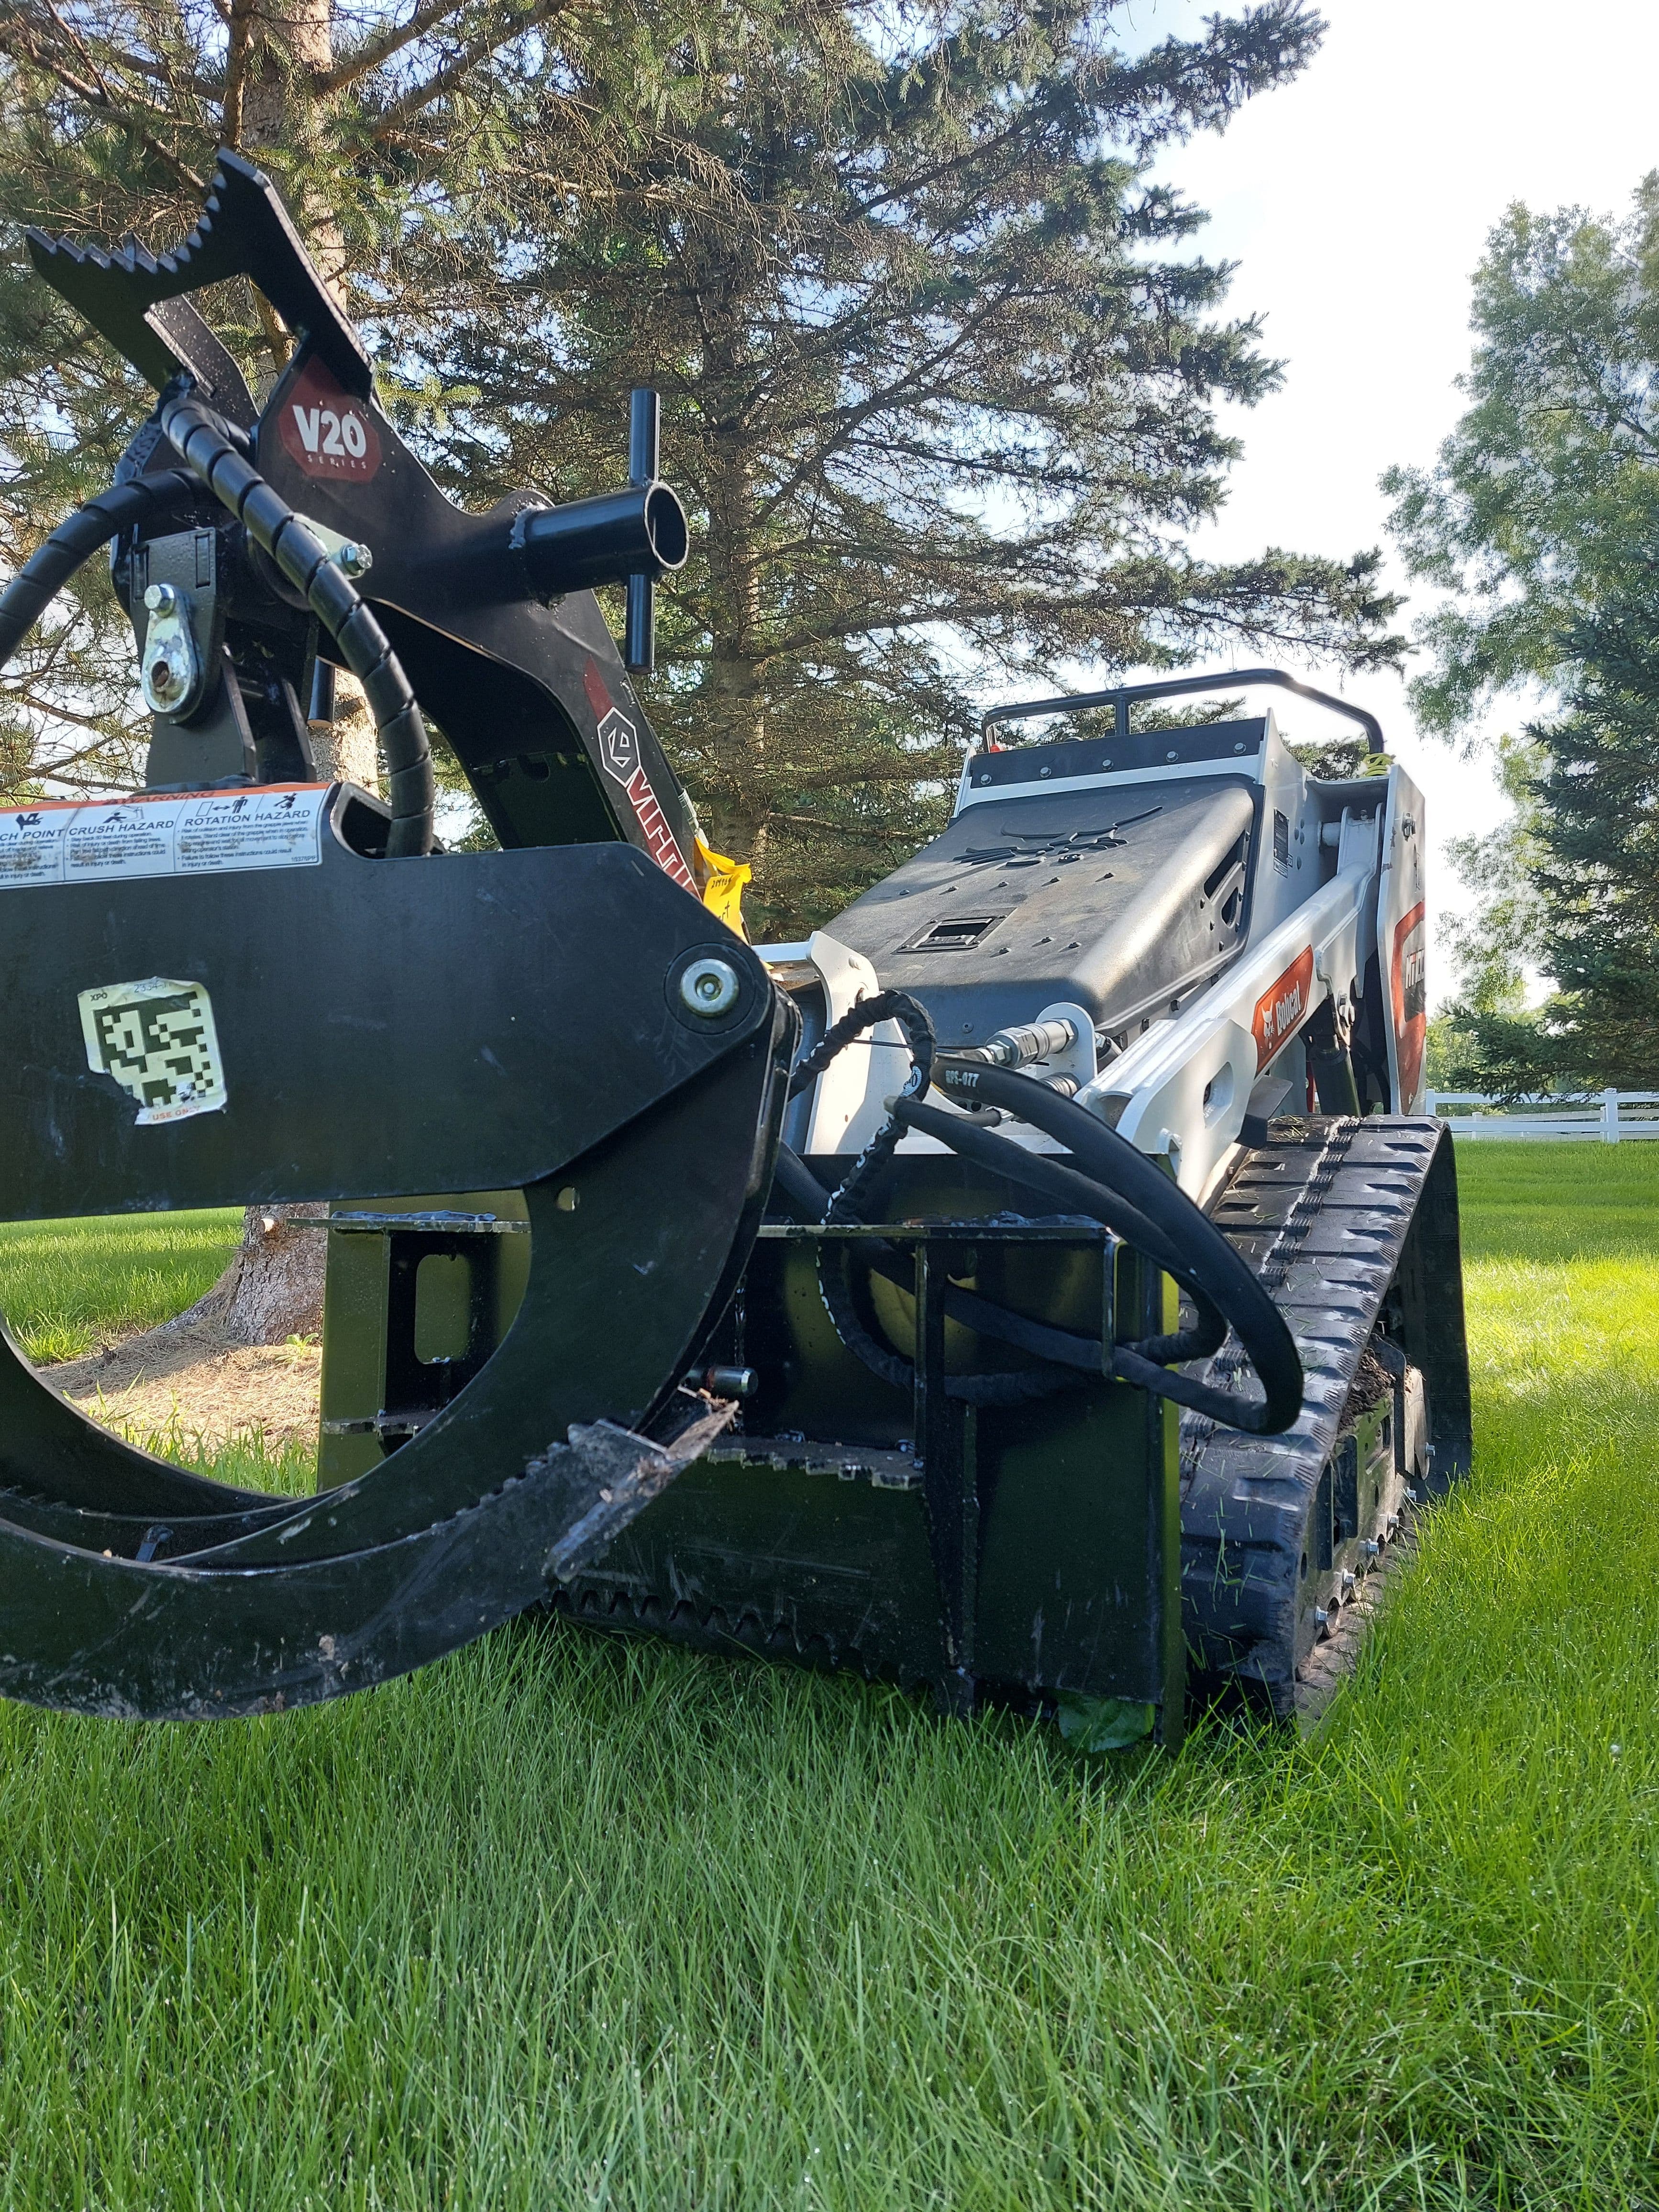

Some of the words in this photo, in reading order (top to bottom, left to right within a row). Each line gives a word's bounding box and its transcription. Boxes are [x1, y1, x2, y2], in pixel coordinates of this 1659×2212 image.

[292, 405, 366, 458] V20
[307, 454, 366, 470] SERIES
[185, 814, 251, 826] ROTATION
[255, 810, 310, 821] HAZARD
[22, 829, 65, 840] POINT
[69, 825, 114, 835] CRUSH
[119, 820, 174, 832] HAZARD
[90, 992, 108, 1002] XPO
[1275, 980, 1302, 1036] Bobcat
[153, 1111, 173, 1120] USE
